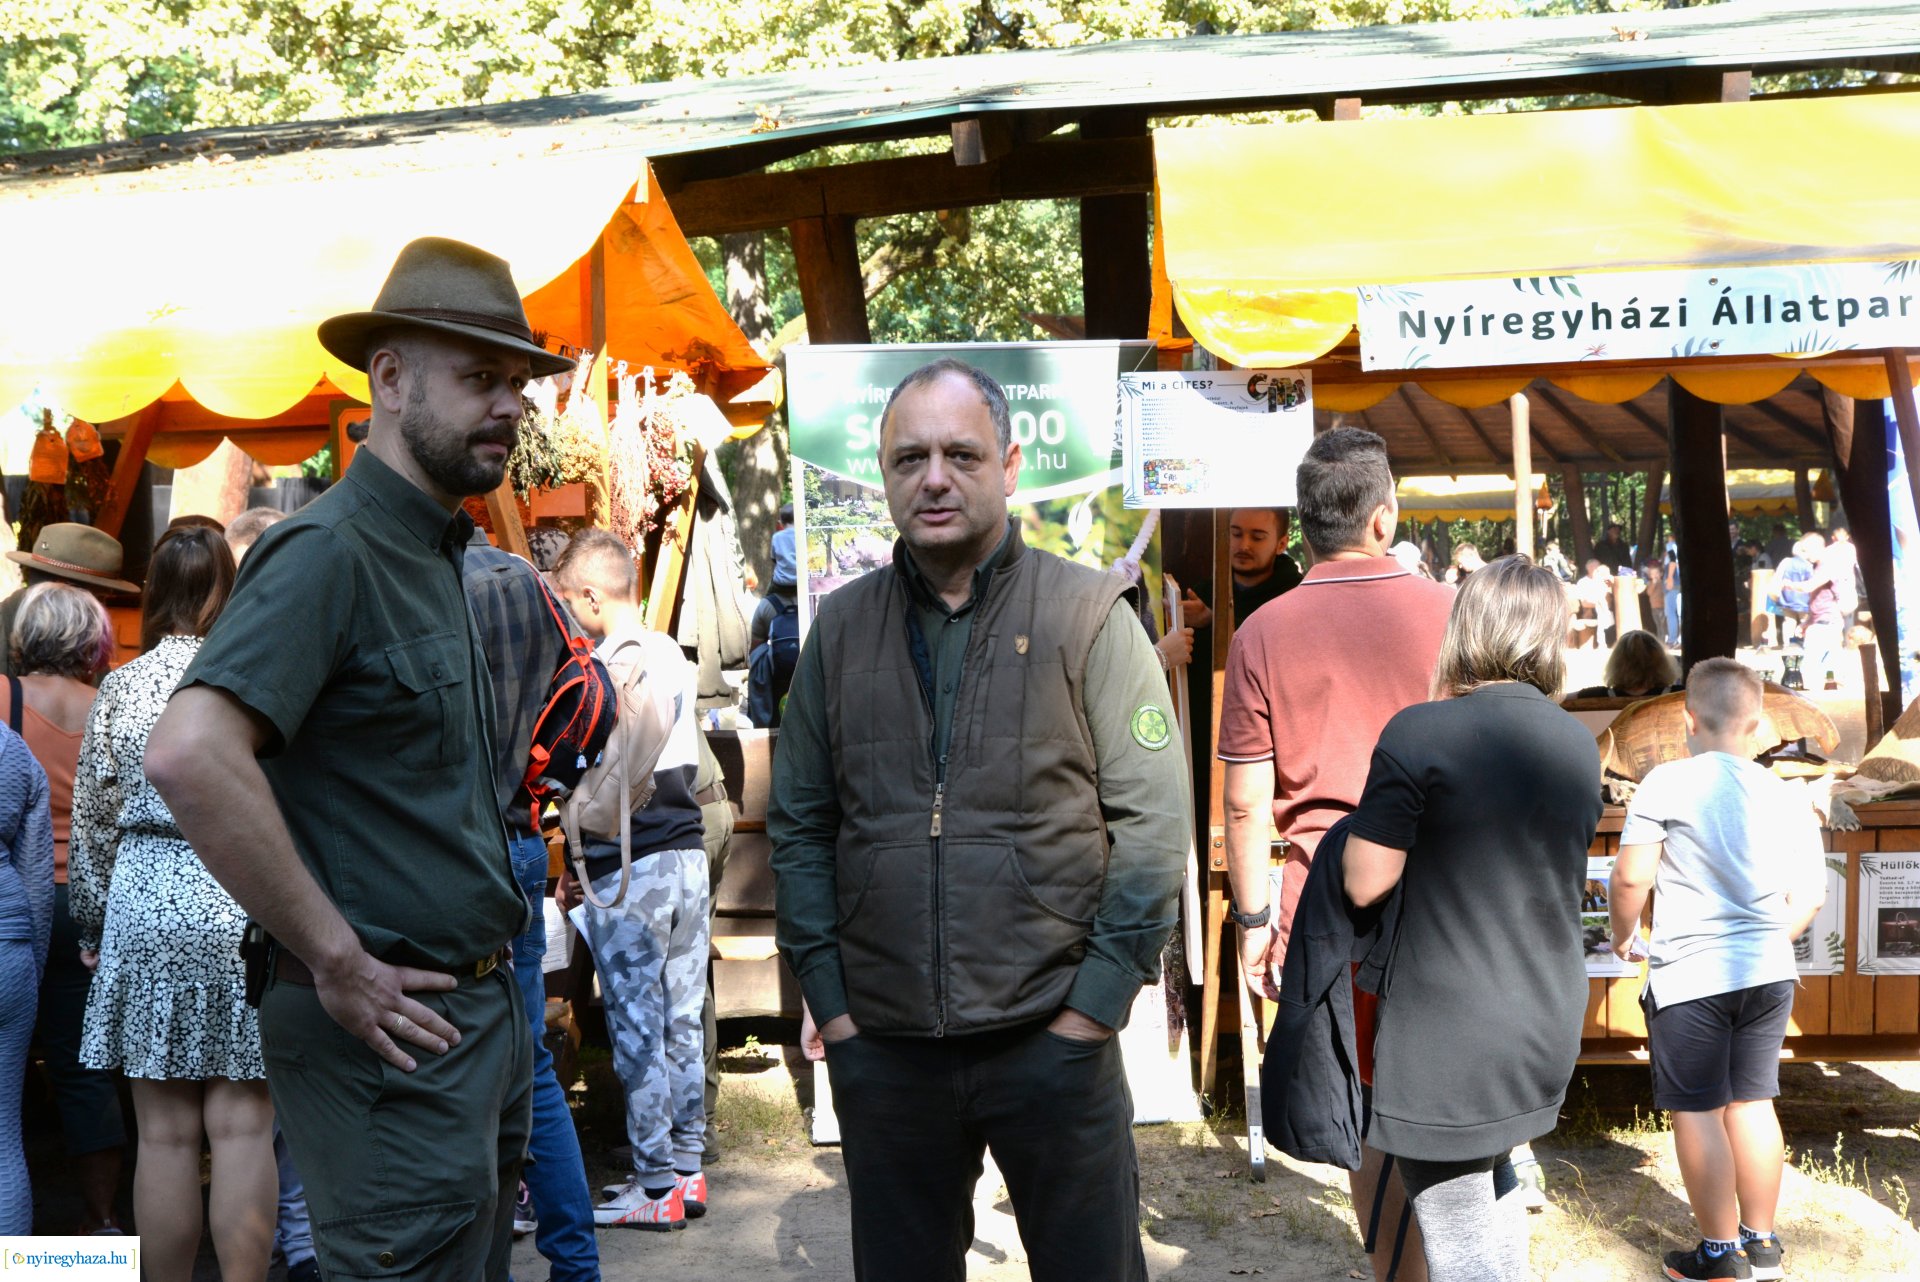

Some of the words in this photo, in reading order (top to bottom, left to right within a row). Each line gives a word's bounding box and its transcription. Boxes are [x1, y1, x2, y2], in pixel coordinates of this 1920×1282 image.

[1399, 296, 1688, 345] Nyíregyházi
[1712, 286, 1913, 327] Állatpar
[1142, 381, 1156, 390] Mi
[1172, 380, 1214, 390] CITES?
[626, 1200, 671, 1223] NIKE
